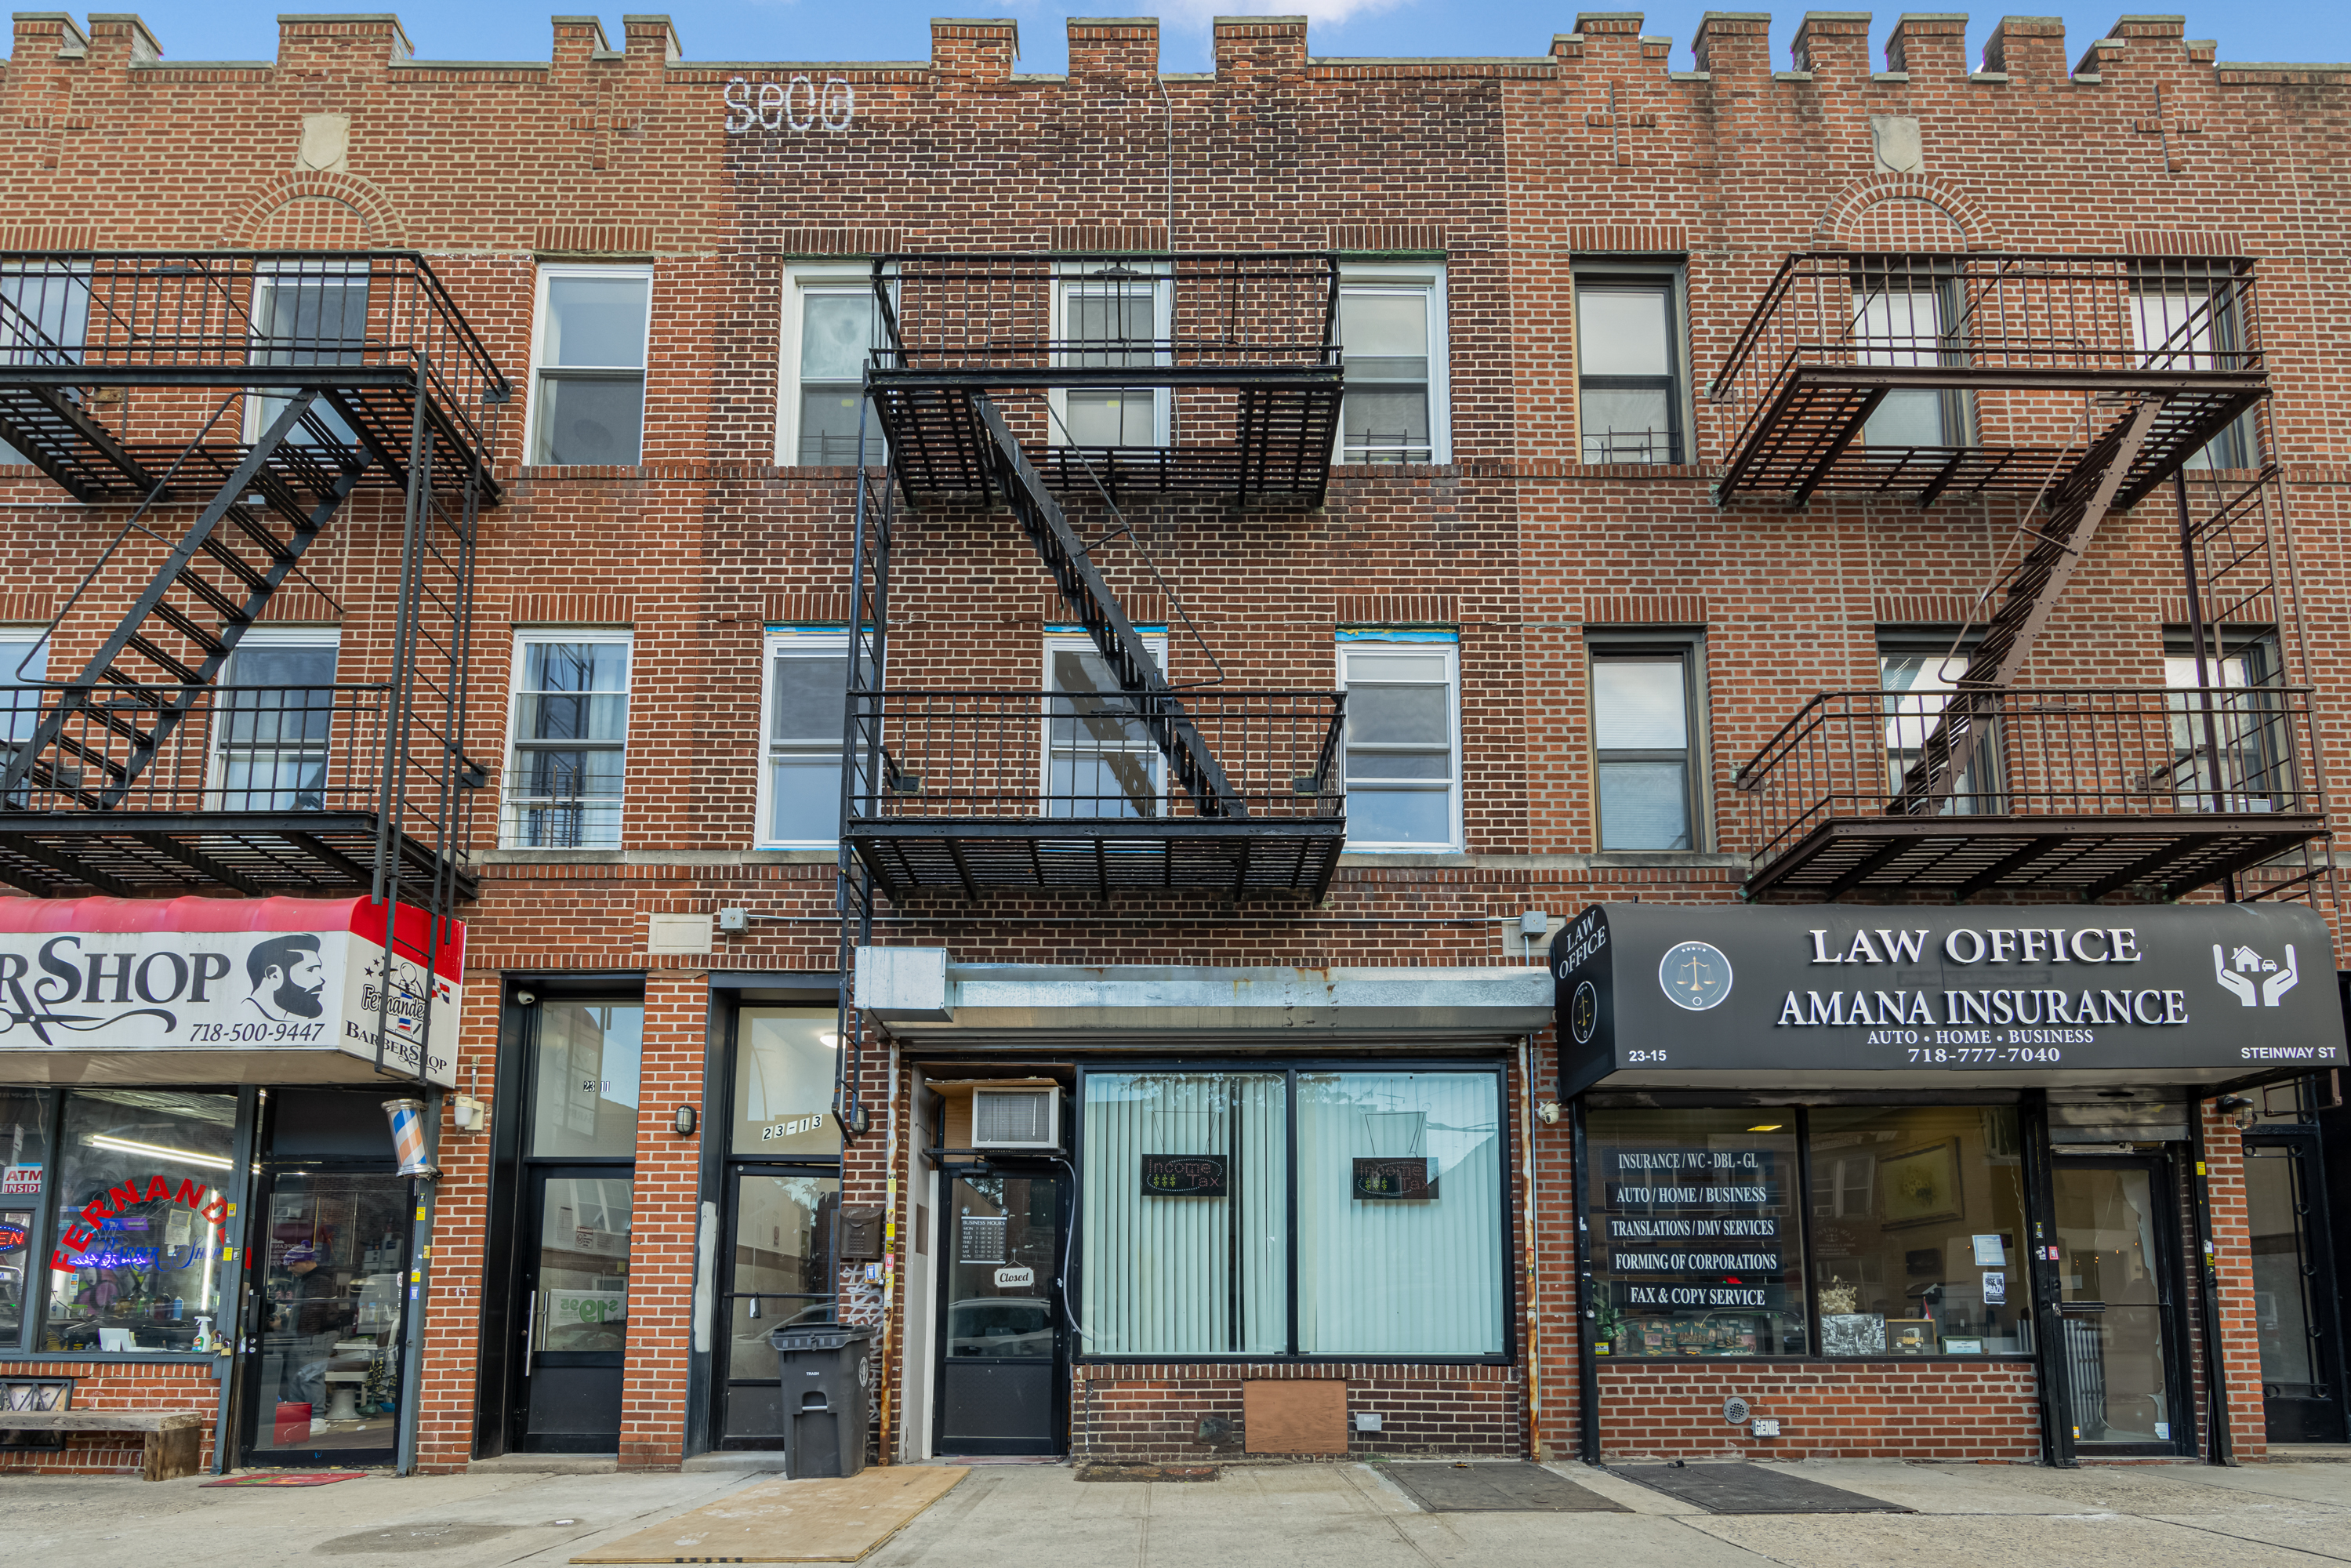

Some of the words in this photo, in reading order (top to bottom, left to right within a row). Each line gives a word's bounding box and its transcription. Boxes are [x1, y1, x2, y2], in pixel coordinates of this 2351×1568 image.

[1566, 910, 1597, 953] LAW
[1559, 925, 1606, 979] OFFICE
[1809, 930, 1929, 964] LAW
[1946, 928, 2141, 964] OFFICE
[362, 985, 426, 1019] Fenande
[1778, 990, 1936, 1025] AMANA
[1944, 989, 2189, 1025] INSURANCE
[190, 1022, 325, 1042] 718-500-9447
[1867, 1029, 1918, 1044] AUTO
[1936, 1029, 1992, 1044] HOME
[2008, 1029, 2094, 1044] BUSINESS
[1629, 1049, 1667, 1062] 23-15
[1907, 1047, 2060, 1062] 718-777-7040
[2240, 1047, 2314, 1059] STEINWAY
[2318, 1047, 2336, 1058] ST
[584, 1081, 595, 1092] 23
[764, 1116, 821, 1140] 23-13
[1149, 1159, 1211, 1174] Income
[1618, 1153, 1680, 1169] INSURANCE
[1687, 1153, 1706, 1168] WC
[1714, 1153, 1735, 1168] DBL
[1743, 1153, 1758, 1168] GL
[5, 1170, 42, 1181] ATM
[1360, 1163, 1423, 1177] Income
[5, 1184, 42, 1193] INSIDE
[1186, 1174, 1219, 1187] Tax
[1398, 1178, 1431, 1190] Tax
[1616, 1187, 1650, 1203] AUTO
[1658, 1187, 1697, 1203] HOME
[1706, 1186, 1767, 1203] BUSINESS
[49, 1175, 228, 1274] FERNAND
[1612, 1220, 1691, 1236] TRANSLATIONS
[1697, 1220, 1722, 1236] DMV
[1723, 1220, 1774, 1236] SERVICES
[87, 1235, 172, 1272] BARBER
[1616, 1254, 1668, 1269] FORMING
[1671, 1254, 1685, 1269] OF
[1688, 1254, 1777, 1270] CORPORATIONS
[1000, 1272, 1029, 1283] Closed
[1631, 1287, 1656, 1303] FAX
[1658, 1287, 1668, 1304] &
[1671, 1288, 1707, 1305] COPY
[1709, 1288, 1765, 1305] SERVICE
[1755, 1421, 1780, 1436] GENIE
